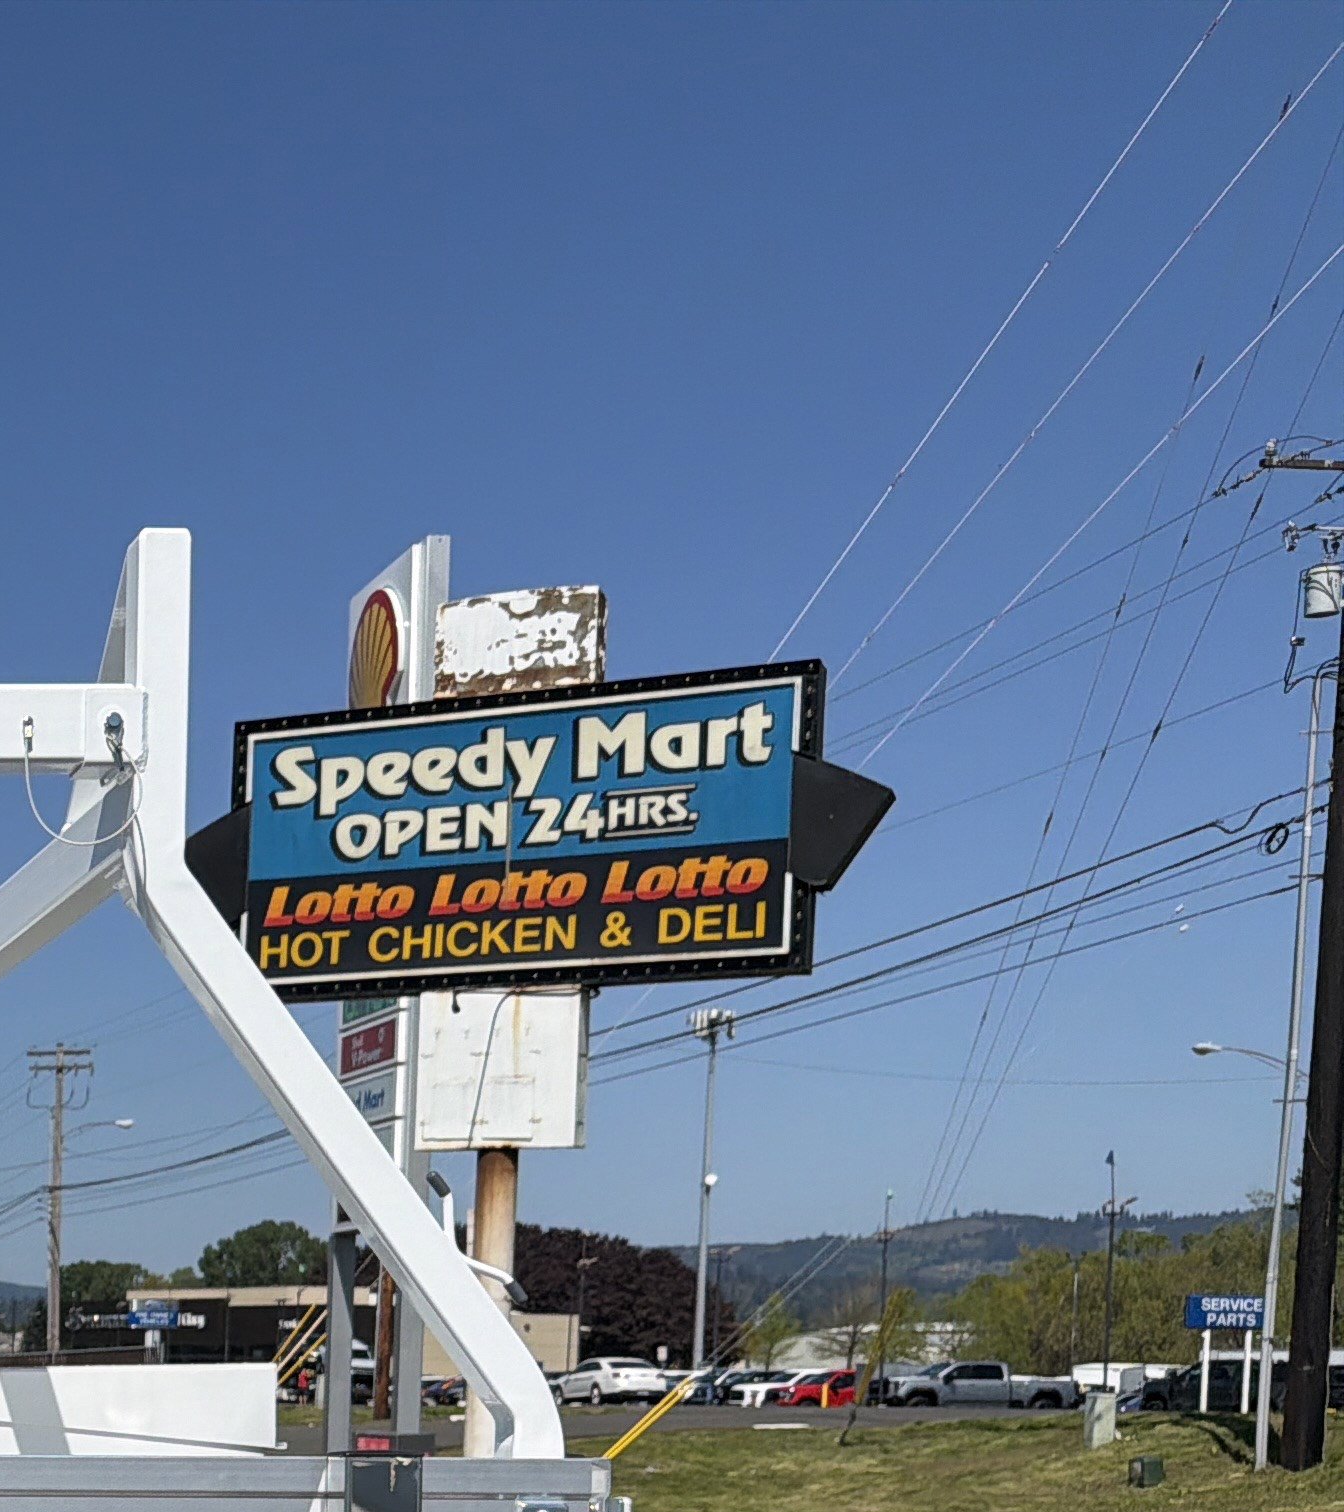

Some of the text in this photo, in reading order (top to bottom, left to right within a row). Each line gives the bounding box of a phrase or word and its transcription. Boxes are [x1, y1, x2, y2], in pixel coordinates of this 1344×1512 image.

[272, 701, 774, 817] Speedy Mart
[334, 804, 508, 860] OPEN
[263, 854, 769, 928] Lotto Lotto Lotto
[259, 901, 767, 970] HOT CHICKEN & DELI
[1200, 1297, 1264, 1313] SERVICE
[1206, 1312, 1257, 1328] PARTS
